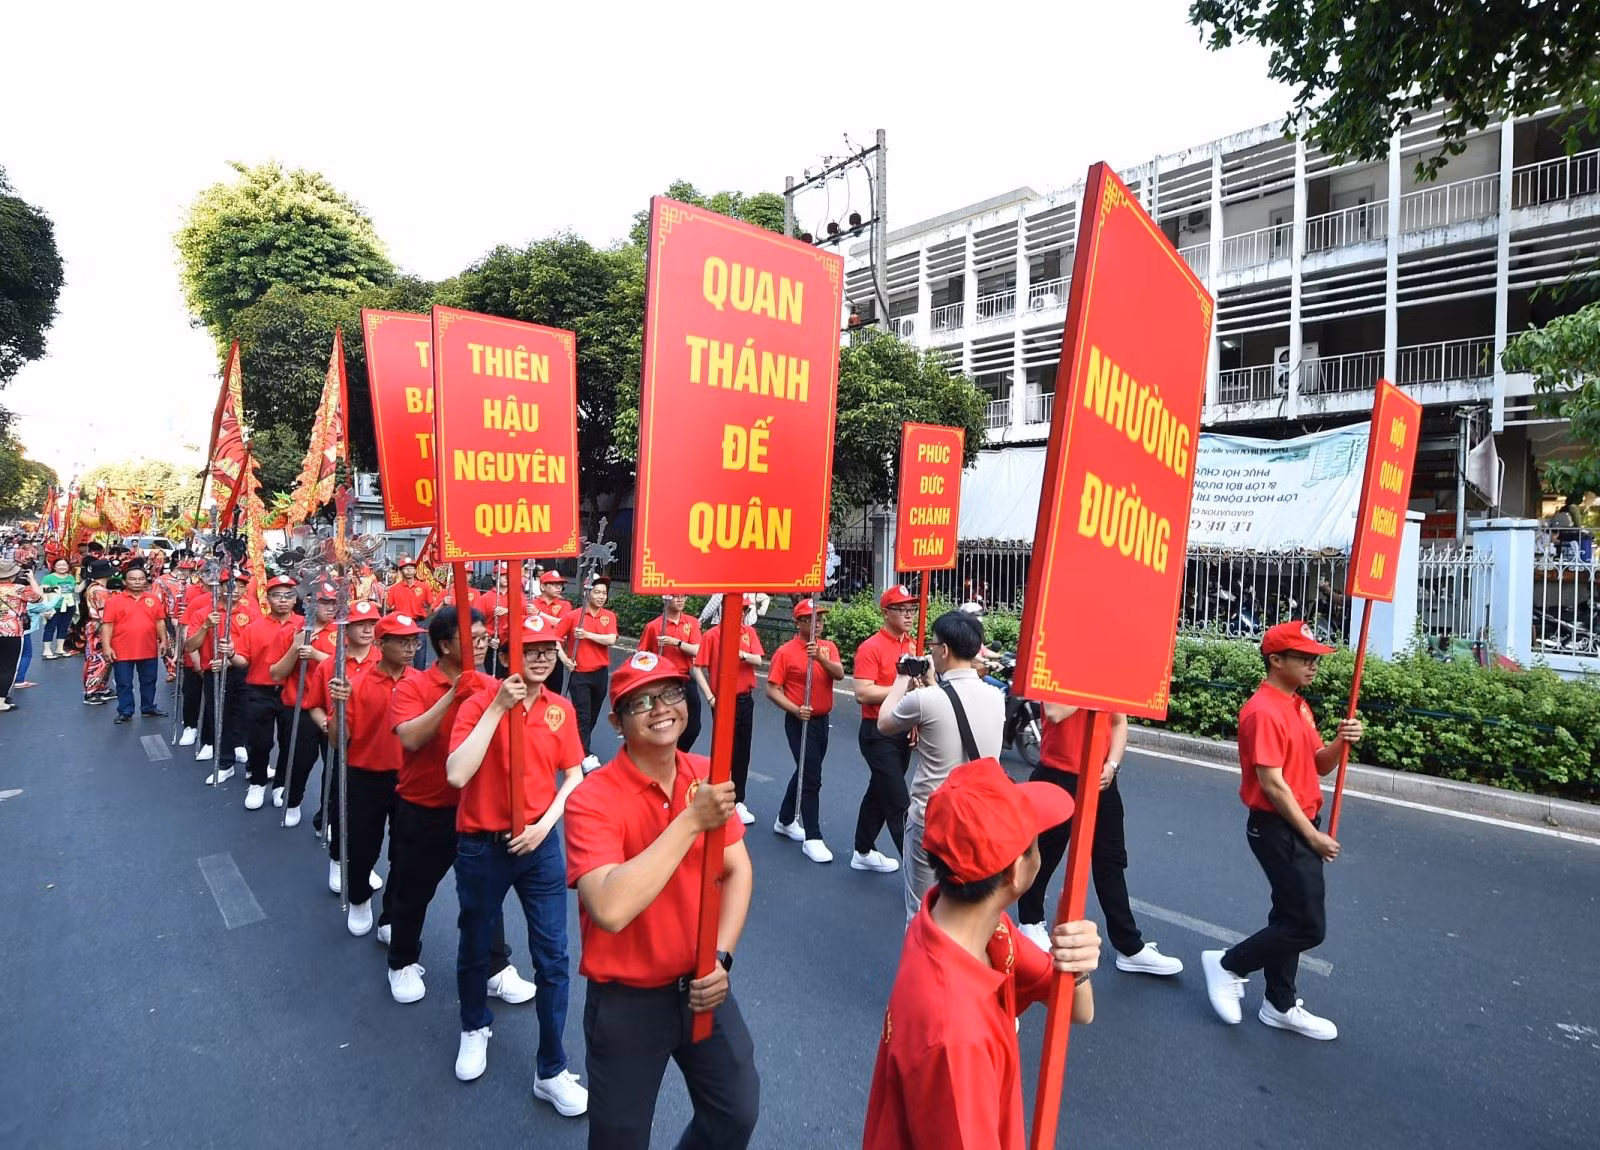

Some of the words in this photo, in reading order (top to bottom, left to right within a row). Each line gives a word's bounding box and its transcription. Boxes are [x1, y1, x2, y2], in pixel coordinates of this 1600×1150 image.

[702, 256, 804, 325] QUAN
[467, 342, 550, 384] THIÊN
[686, 335, 810, 403] THÁNH
[483, 395, 540, 438] HẬU
[1083, 345, 1191, 479] NHƯỜNG
[415, 433, 434, 459] T
[721, 415, 775, 473] ĐẾ
[917, 442, 951, 465] PHÚC
[1389, 416, 1408, 452] HỘI
[454, 446, 566, 484] NGUYÊN
[919, 473, 945, 495] ĐỨC
[1379, 460, 1404, 496] QUÁN
[415, 478, 436, 507] Q
[475, 497, 551, 537] QUÂN
[689, 496, 792, 554] QUÂN
[909, 504, 952, 526] CHÁNH
[1077, 471, 1172, 574] ĐƯỜNG
[1369, 552, 1386, 580] AN
